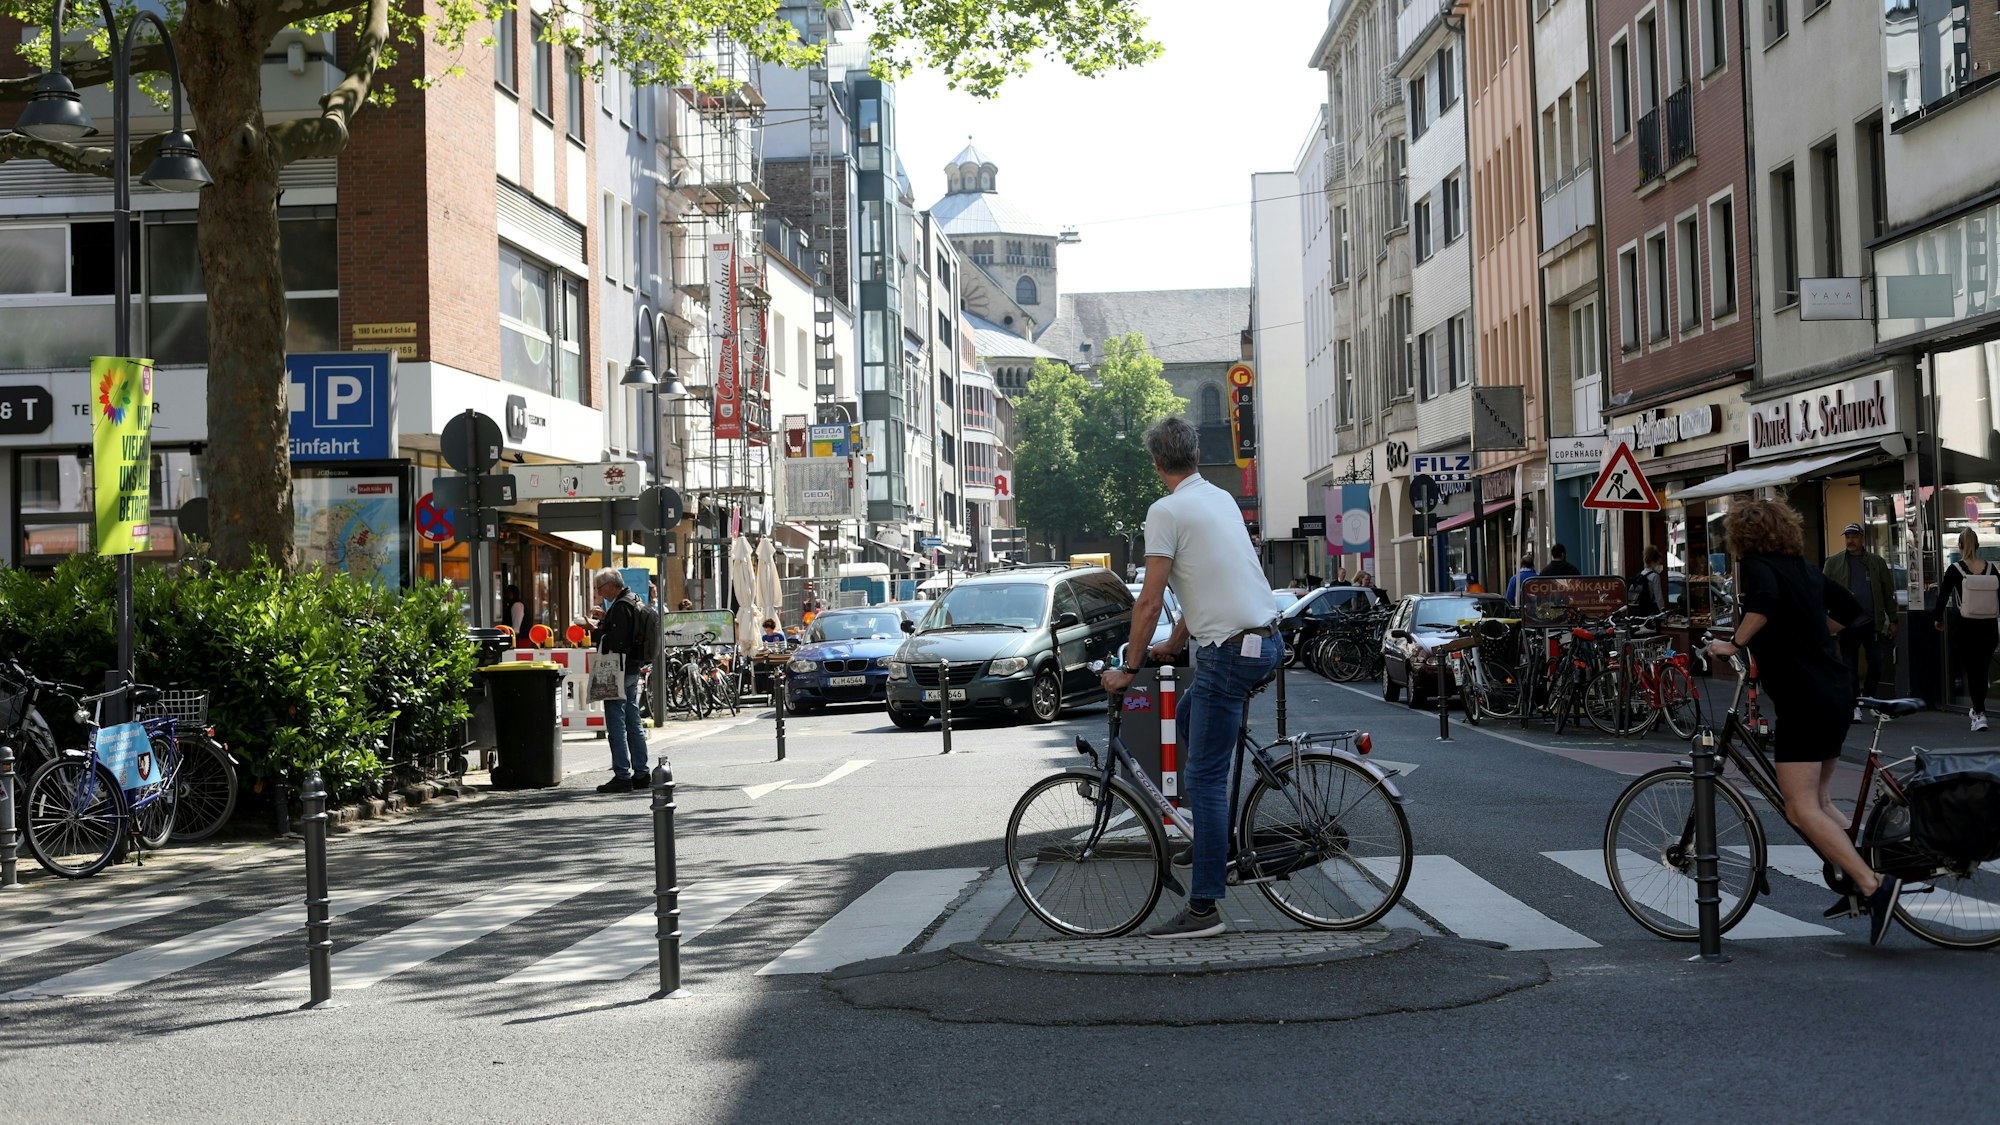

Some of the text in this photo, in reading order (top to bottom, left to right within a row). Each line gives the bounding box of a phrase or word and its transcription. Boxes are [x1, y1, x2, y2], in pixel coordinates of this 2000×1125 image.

[394, 325, 411, 334] Schad
[399, 346, 412, 354] 169
[714, 344, 735, 401] Colonia
[327, 375, 363, 420] P
[21, 398, 39, 421] T
[813, 427, 843, 435] GEDA
[289, 437, 360, 455] Einfahrt
[1415, 455, 1470, 473] FILZ
[119, 465, 138, 492] UNS
[1529, 581, 1619, 593] GOLDANKAUF
